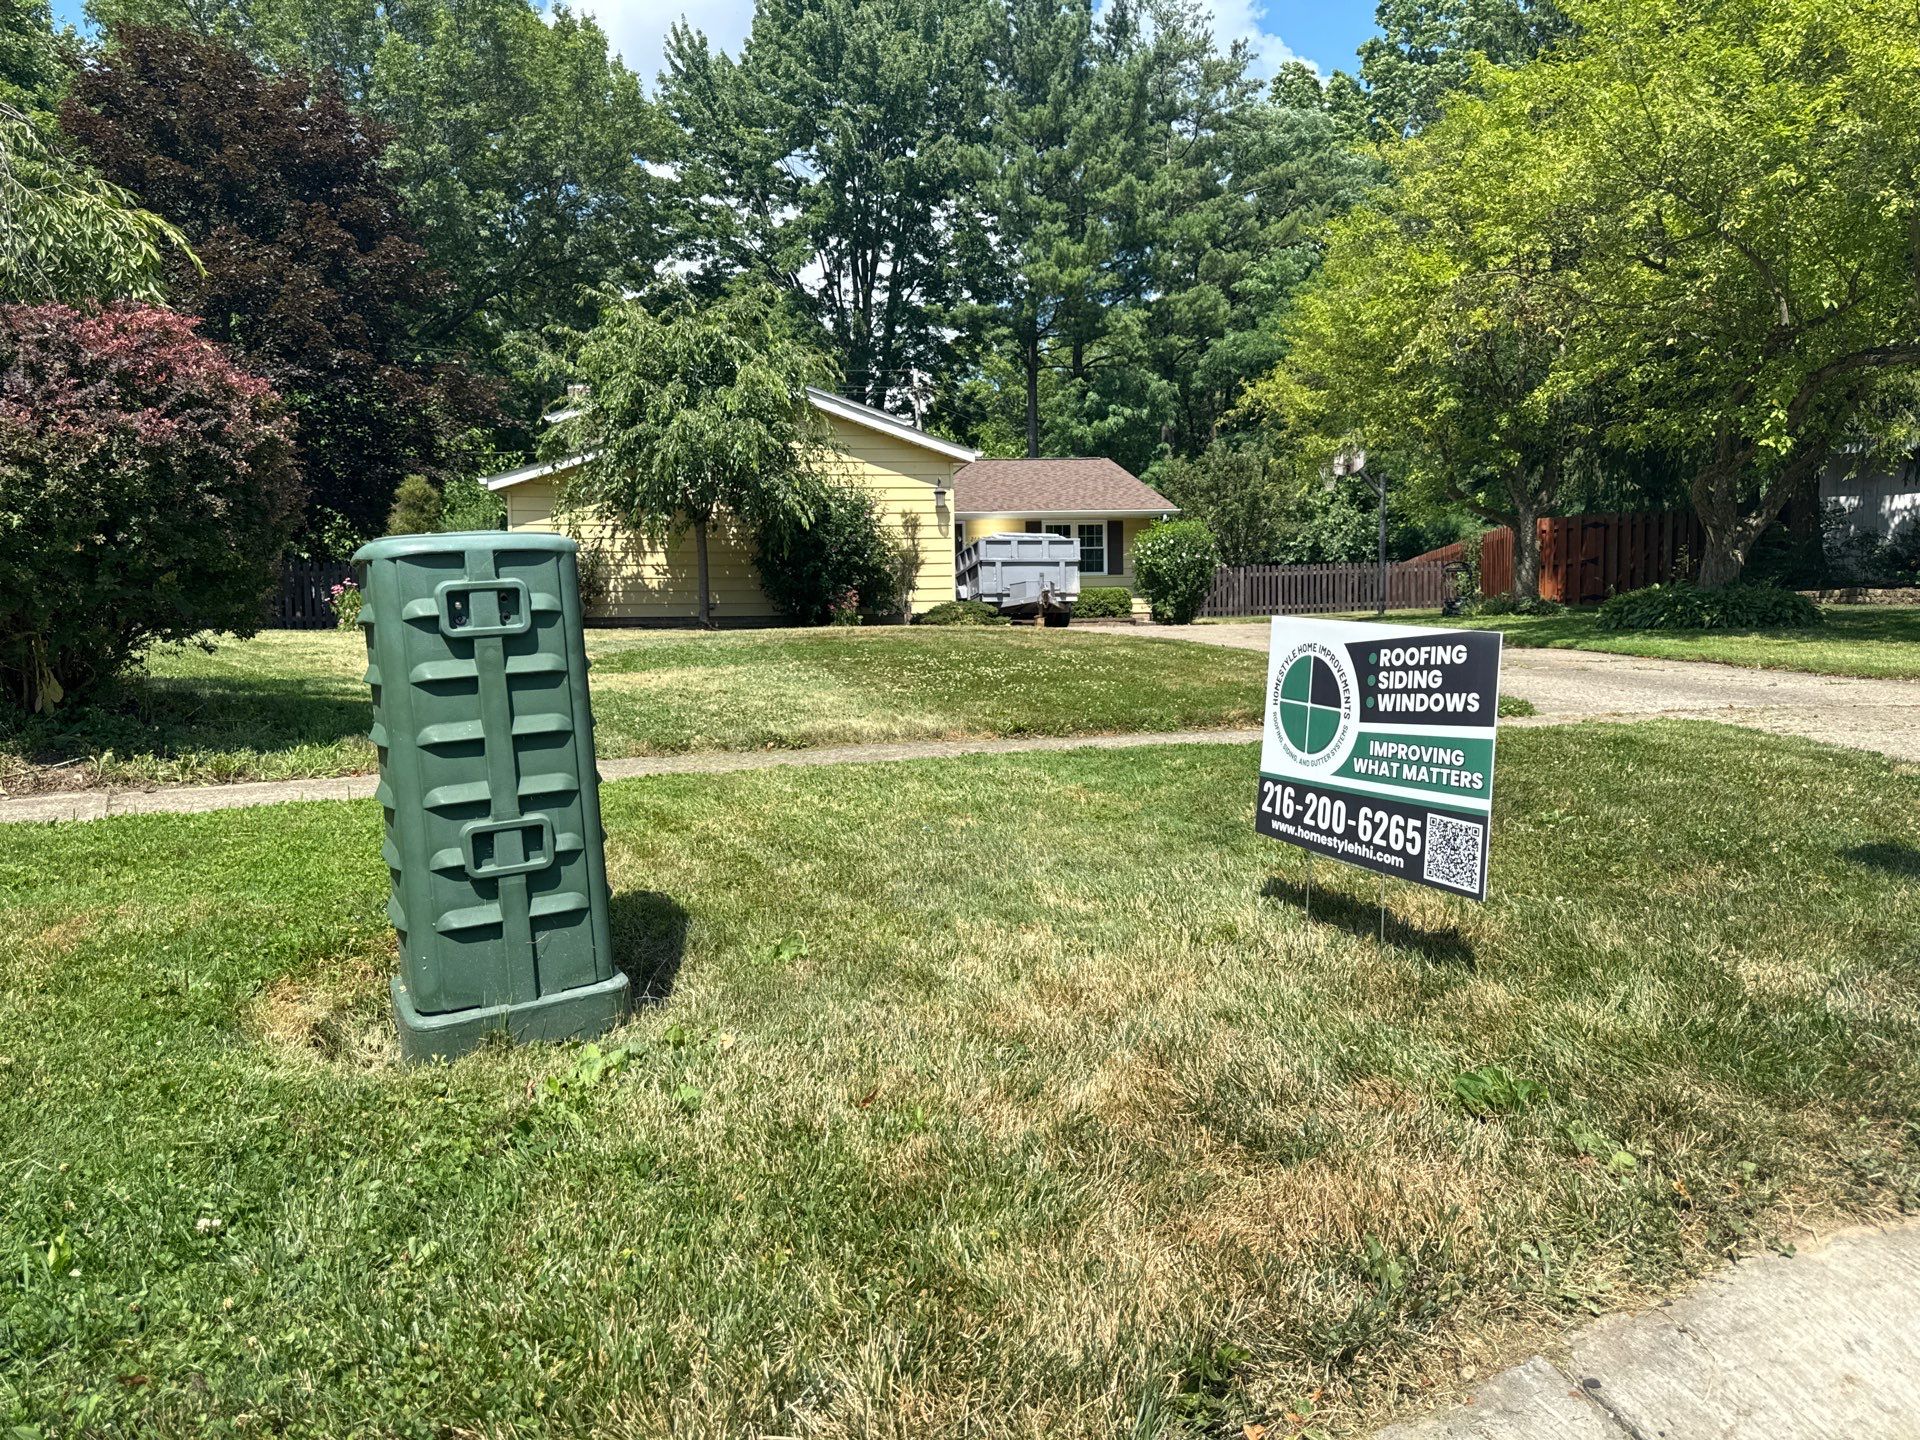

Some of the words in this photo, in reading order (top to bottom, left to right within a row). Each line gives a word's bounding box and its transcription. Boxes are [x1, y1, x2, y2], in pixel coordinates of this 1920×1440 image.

[1379, 645, 1468, 667] ROOFING
[1273, 649, 1298, 706] HOMESTYLE
[1298, 643, 1318, 655] HOME
[1318, 644, 1351, 720] IMPROVEMENTS
[1378, 669, 1443, 689] SIDING
[1377, 692, 1480, 712] WINDOWS
[1298, 758, 1310, 767] AND
[1310, 753, 1331, 767] GUTTER
[1331, 725, 1349, 757] SYSTEMS
[1369, 740, 1465, 767] IMPROVING
[1353, 757, 1400, 779] WHAT
[1402, 764, 1484, 790] MATTERS
[1261, 780, 1422, 856] 216-200-6265
[1271, 819, 1405, 869] www.homestylehhi.com
